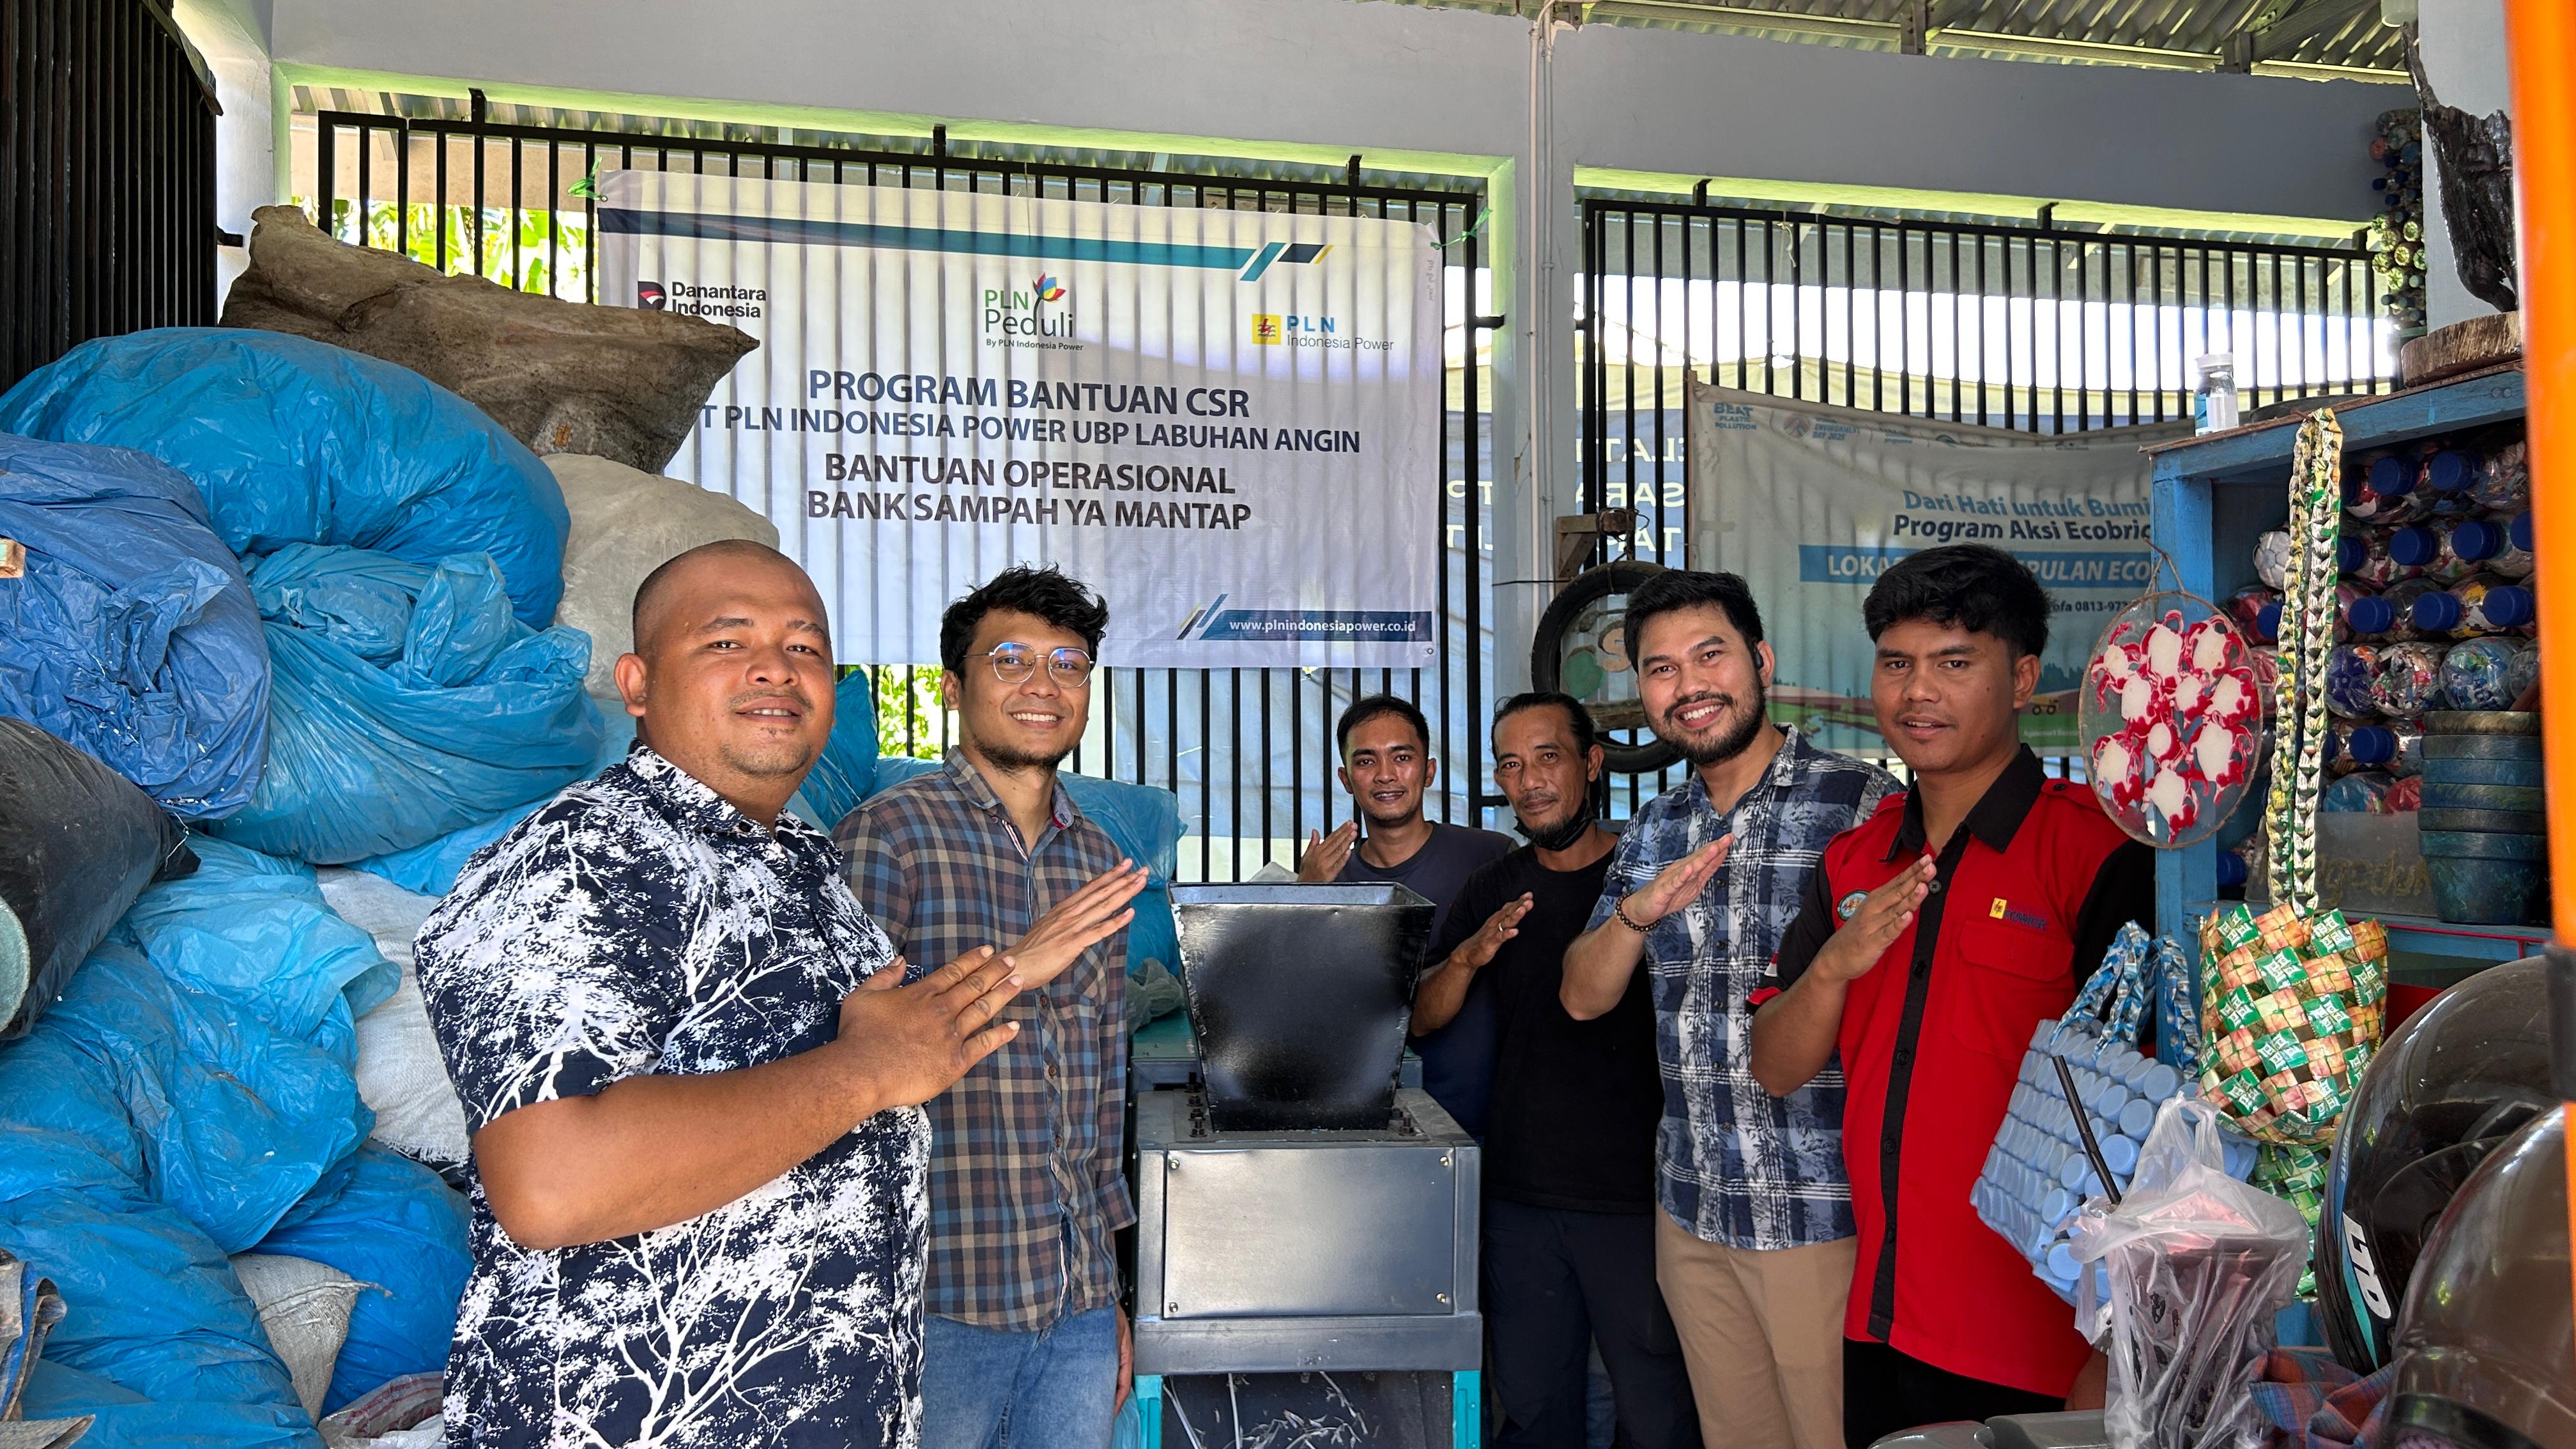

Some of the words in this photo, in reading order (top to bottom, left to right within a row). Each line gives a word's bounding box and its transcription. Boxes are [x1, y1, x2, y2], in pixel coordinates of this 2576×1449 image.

[672, 281, 767, 301] Danantara
[985, 289, 1029, 310] PLN
[672, 299, 761, 318] Indonesia
[985, 308, 1074, 338] Peduli
[1287, 315, 1335, 333] PLN
[986, 339, 997, 348] By
[999, 339, 1015, 348] PLN
[1016, 340, 1056, 349] Indonesia
[1058, 342, 1084, 351] Power
[1287, 334, 1351, 349] Indonesia
[1354, 337, 1394, 351] Power
[810, 369, 997, 407] PROGRAM
[1007, 379, 1177, 415] BANTUAN
[1186, 388, 1250, 418] CSR
[1713, 402, 1754, 416] BEAT
[702, 404, 718, 427] T
[725, 406, 783, 431] PLN
[791, 408, 956, 438] INDONESIA
[963, 416, 1066, 443] POWER
[1073, 420, 1130, 445] UBP
[1136, 424, 1268, 450] LABUHAN
[1275, 429, 1360, 453] ANGIN
[825, 453, 995, 487] BANTUAN
[1003, 460, 1236, 494] OPERASIONAL
[808, 491, 908, 521] BANK
[914, 494, 1059, 525] SAMPAH
[1065, 499, 1108, 526] YA
[1115, 501, 1252, 530] MANTAP
[1903, 490, 1954, 512] Dari
[1956, 495, 2008, 515] Hati
[2011, 498, 2085, 518] untuk
[2087, 497, 2150, 518] Bumi
[1893, 514, 2004, 542] Program
[2010, 520, 2061, 540] Aksi
[2064, 520, 2150, 540] Ecobric
[2109, 560, 2151, 581] ECO
[1229, 619, 1416, 633] www.plnindonesiapower.co.id
